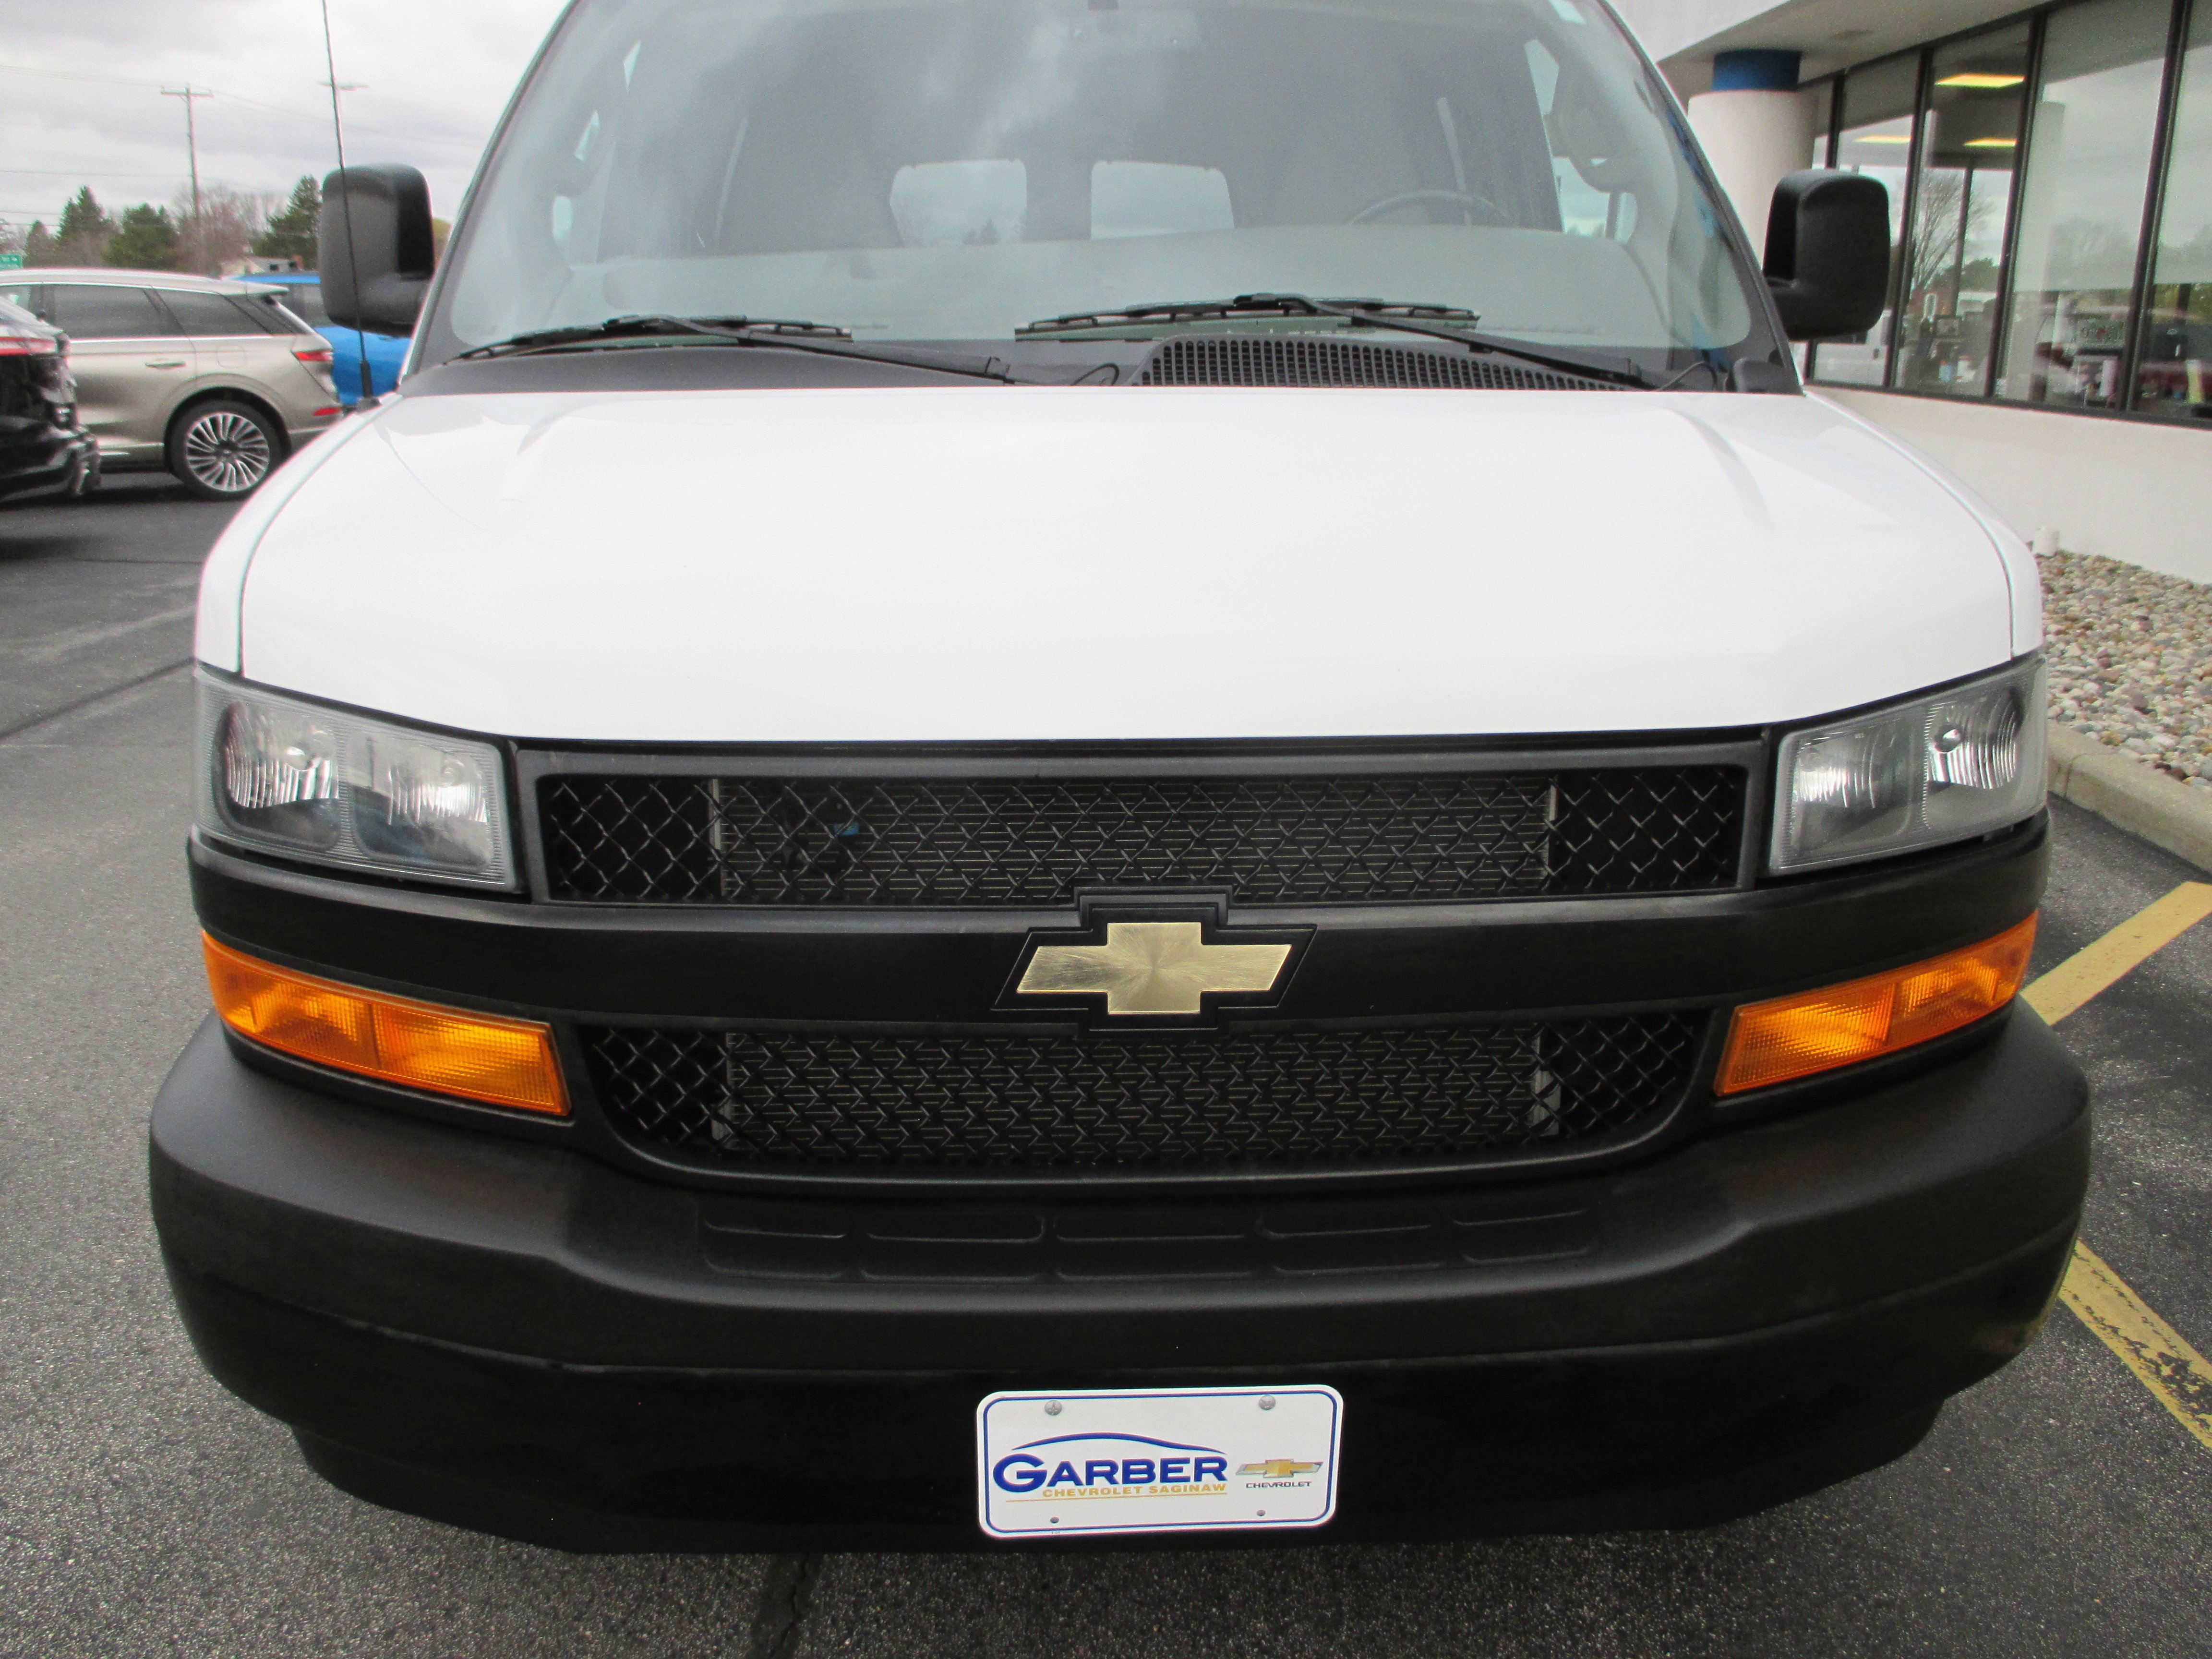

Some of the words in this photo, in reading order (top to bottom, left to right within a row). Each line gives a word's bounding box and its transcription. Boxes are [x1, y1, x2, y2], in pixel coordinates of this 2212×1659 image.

[993, 1453, 1228, 1492] GARBER
[1042, 1486, 1142, 1497] CHEVROLET
[1148, 1484, 1226, 1494] SAGINAW
